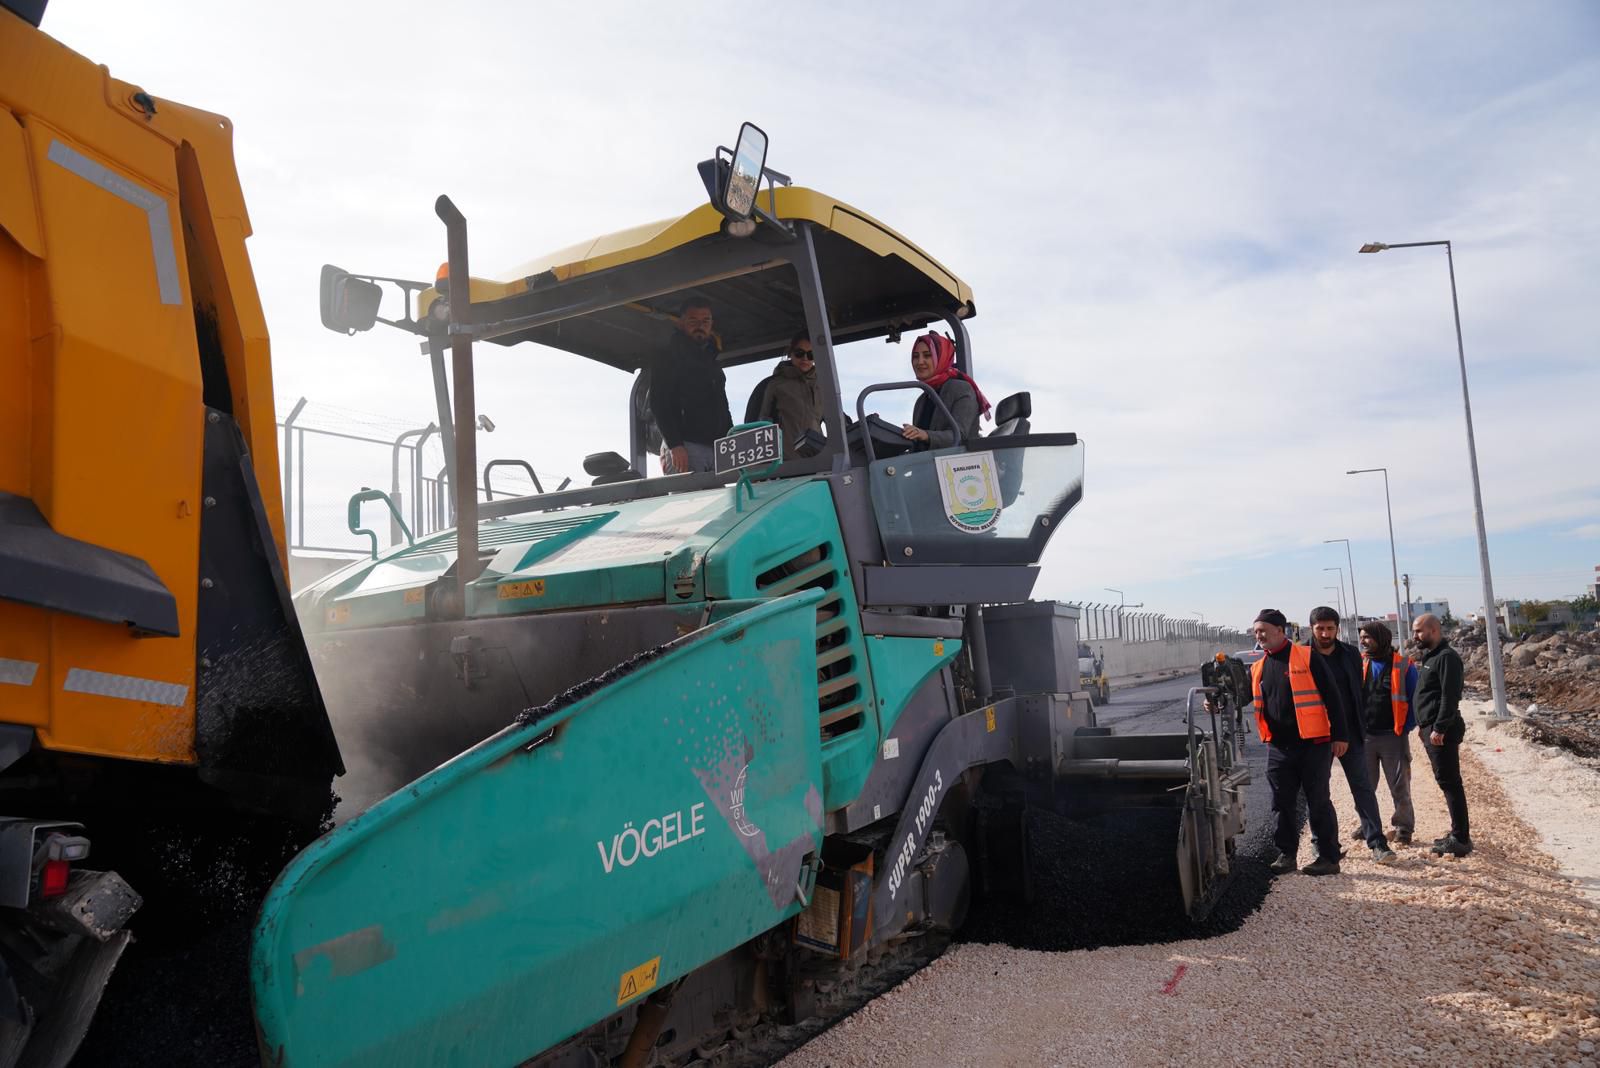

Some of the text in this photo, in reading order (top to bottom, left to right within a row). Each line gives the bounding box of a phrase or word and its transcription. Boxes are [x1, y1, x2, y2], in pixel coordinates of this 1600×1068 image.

[720, 429, 774, 454] 63 FN
[730, 444, 774, 466] 15325
[597, 802, 705, 874] VÖGELE
[888, 768, 943, 900] SUPER 1900-3
